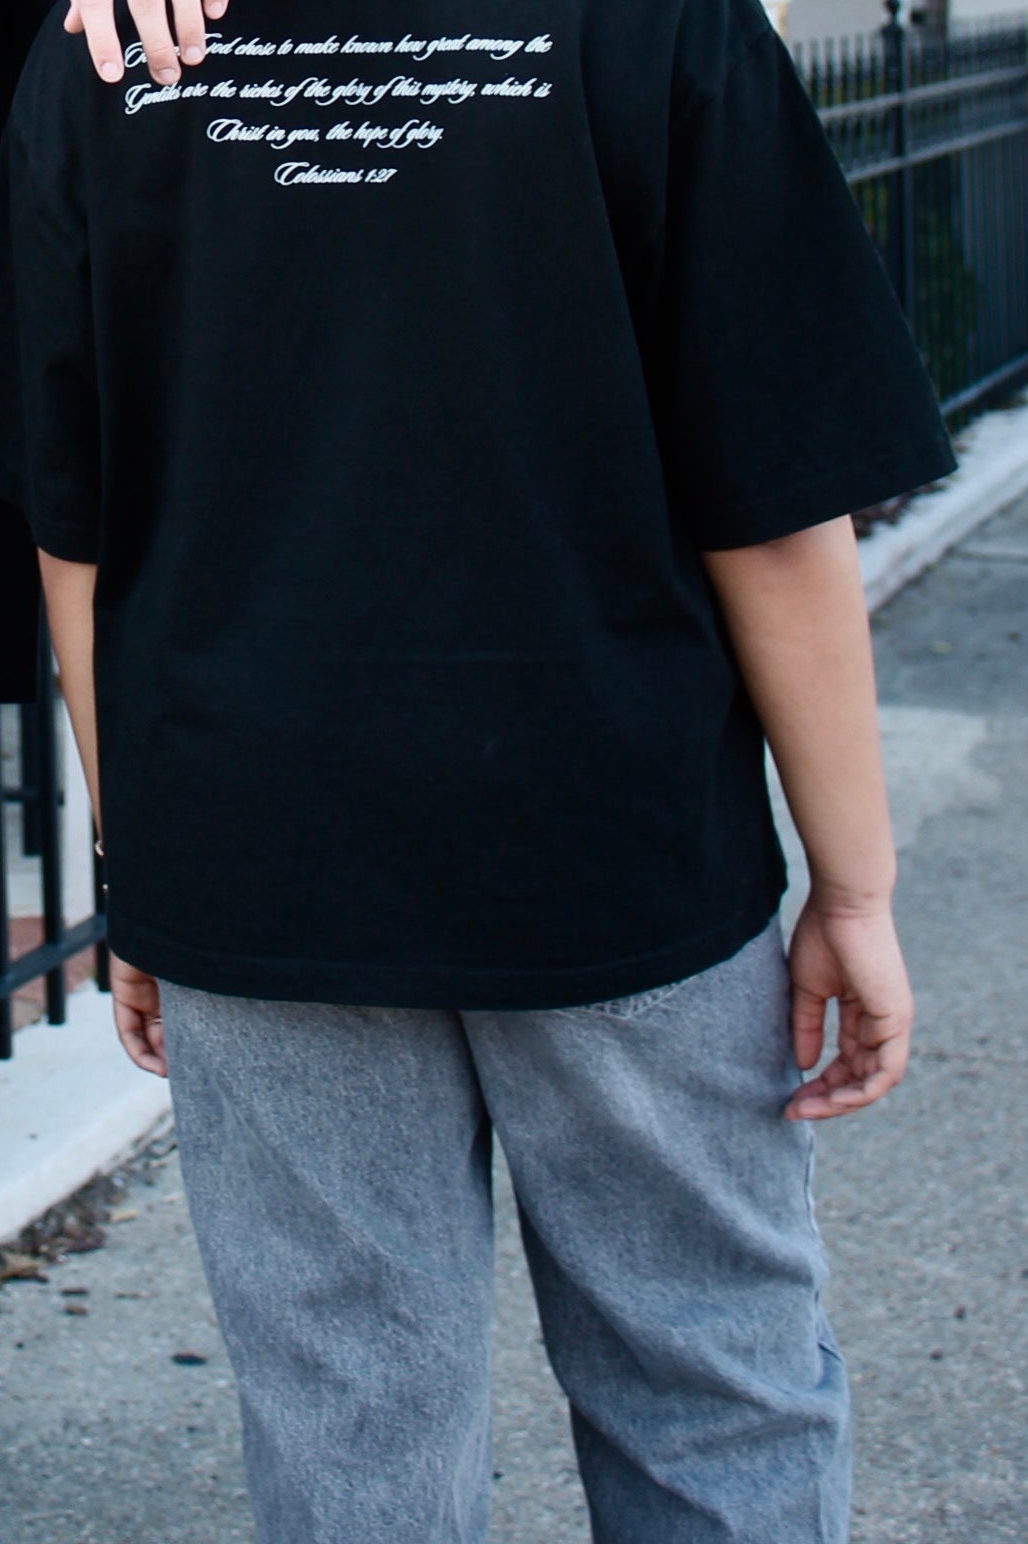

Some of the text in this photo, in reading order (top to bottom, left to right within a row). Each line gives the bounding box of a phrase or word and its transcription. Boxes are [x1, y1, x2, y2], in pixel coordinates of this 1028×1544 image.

[234, 37, 276, 55] chose
[277, 38, 293, 55] to
[294, 35, 340, 54] make
[340, 35, 394, 53] known
[413, 34, 471, 61] great
[465, 38, 524, 60] among
[524, 34, 553, 53] the
[182, 83, 209, 98] are
[209, 79, 237, 98] the
[239, 79, 284, 98] riches
[270, 77, 318, 106] of
[303, 78, 331, 98] the
[315, 78, 373, 106] glory
[362, 75, 406, 105] of
[391, 77, 423, 97] this
[480, 77, 537, 97] which
[533, 82, 552, 98] is
[125, 82, 182, 115] Gentiles
[207, 118, 270, 142] Christ
[265, 126, 285, 141] in
[270, 128, 320, 150] you,
[325, 121, 353, 140] the
[353, 121, 388, 148] hope
[376, 119, 419, 148] of
[274, 161, 363, 186] Colossians
